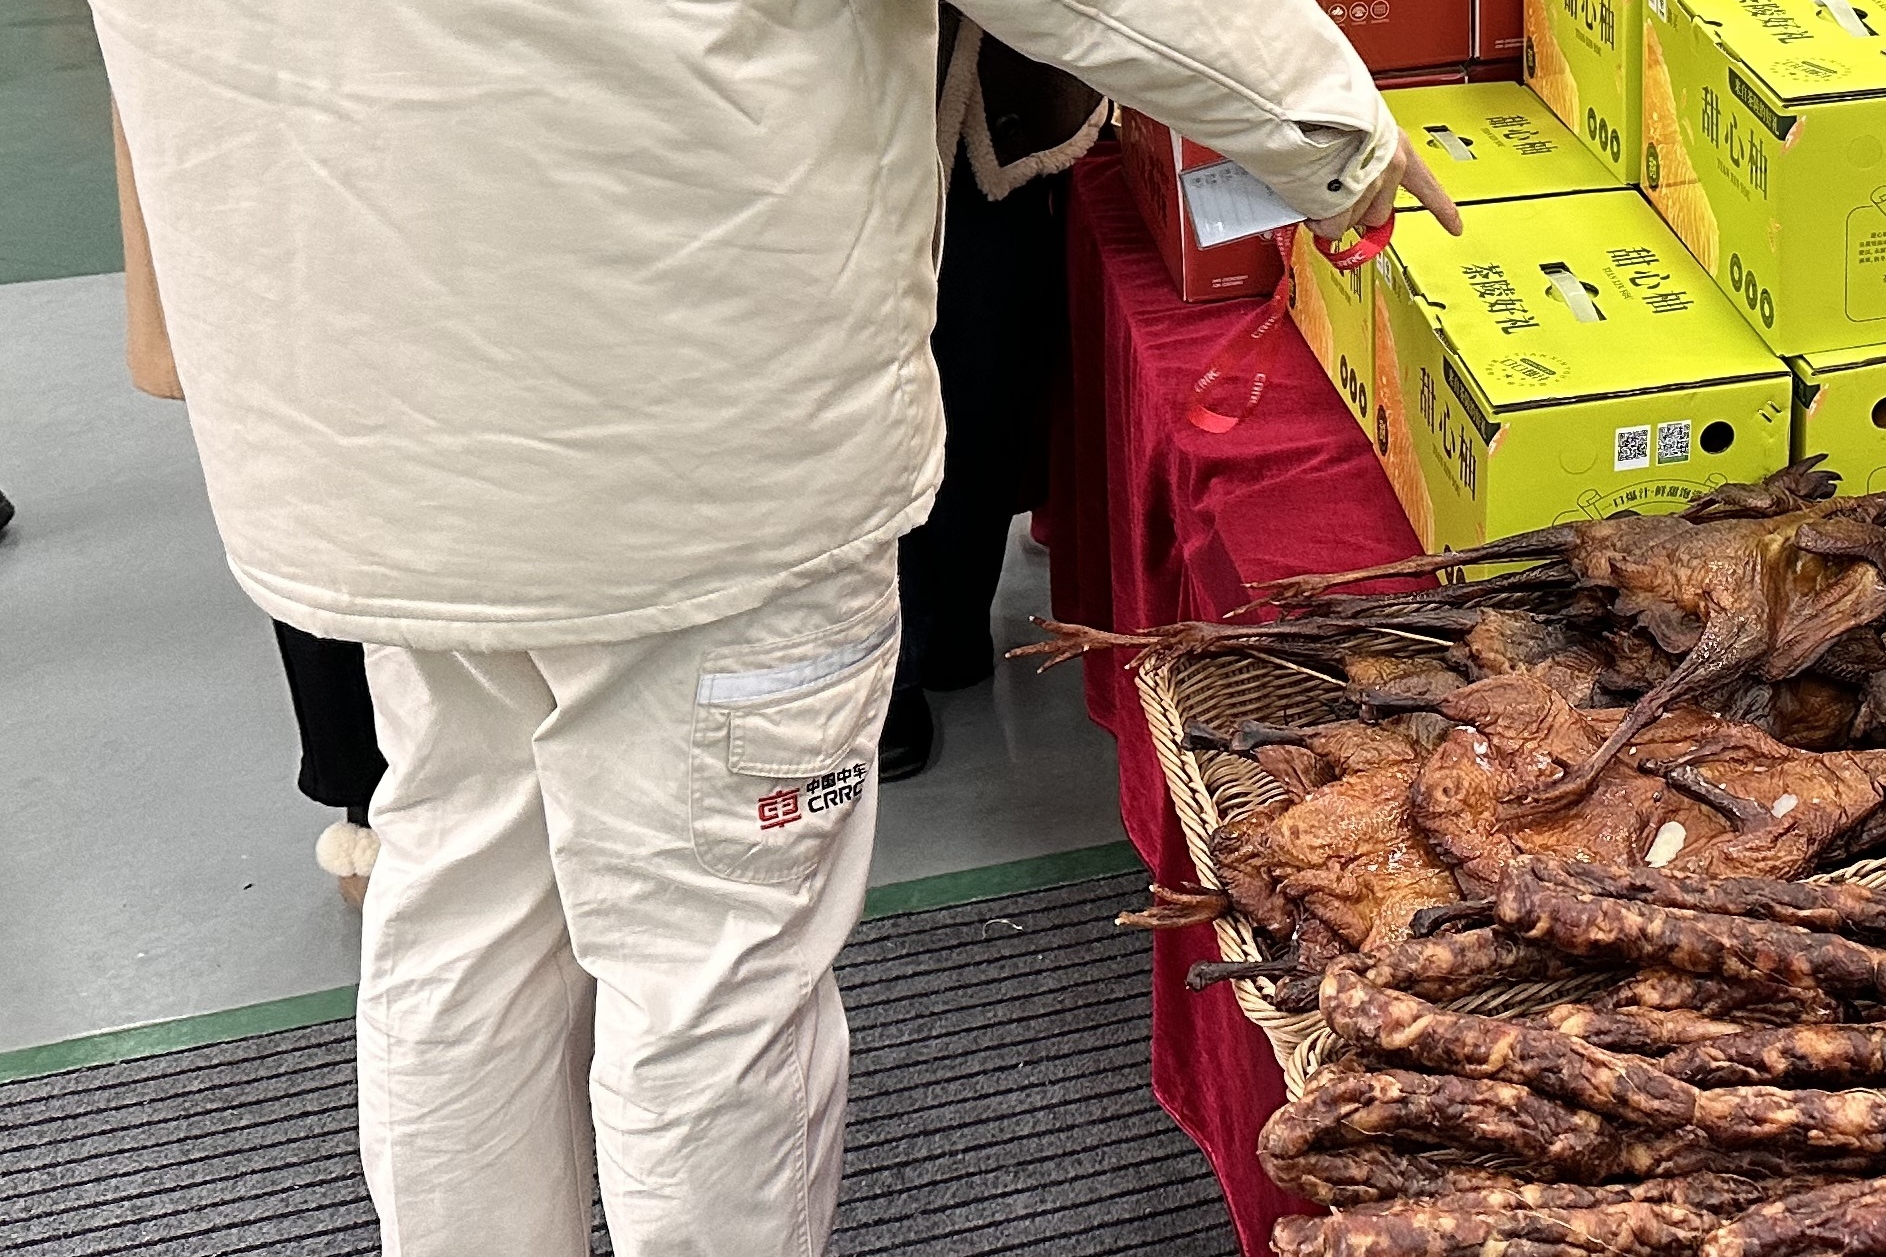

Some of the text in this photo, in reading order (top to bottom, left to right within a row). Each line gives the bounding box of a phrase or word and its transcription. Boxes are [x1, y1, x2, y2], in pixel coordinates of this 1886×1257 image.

[1701, 85, 1769, 201] 甜心柚
[1420, 366, 1478, 502] 甜心柚
[806, 762, 868, 795] 中国中车
[806, 778, 866, 814] CRRC
